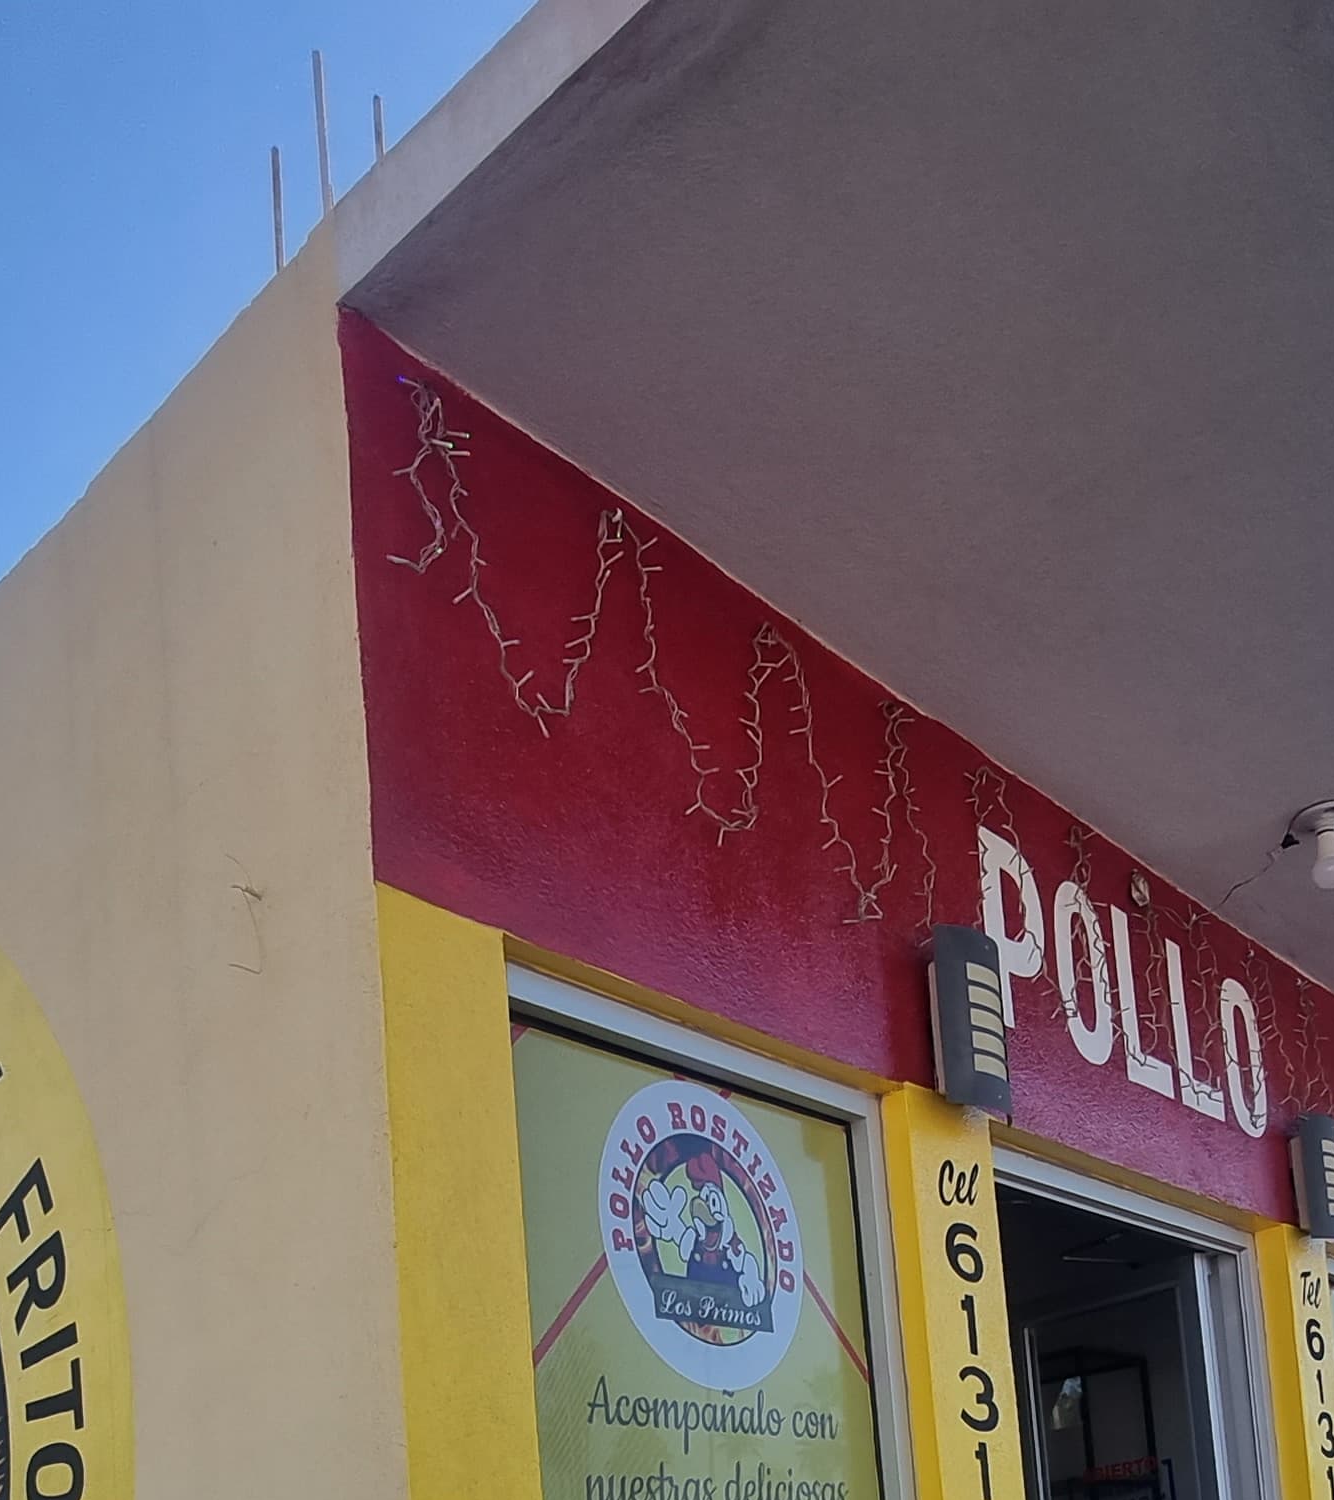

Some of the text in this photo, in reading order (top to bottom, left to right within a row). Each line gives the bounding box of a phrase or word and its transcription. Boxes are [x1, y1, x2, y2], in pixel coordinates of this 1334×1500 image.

[978, 825, 1268, 1139] POLLO
[609, 1101, 796, 1294] POLLO ROSTIZADO
[938, 1159, 979, 1207] Cel
[660, 1288, 763, 1327] Los Primos
[1300, 1270, 1322, 1309] Tel
[586, 1374, 839, 1455] Acompañalo con
